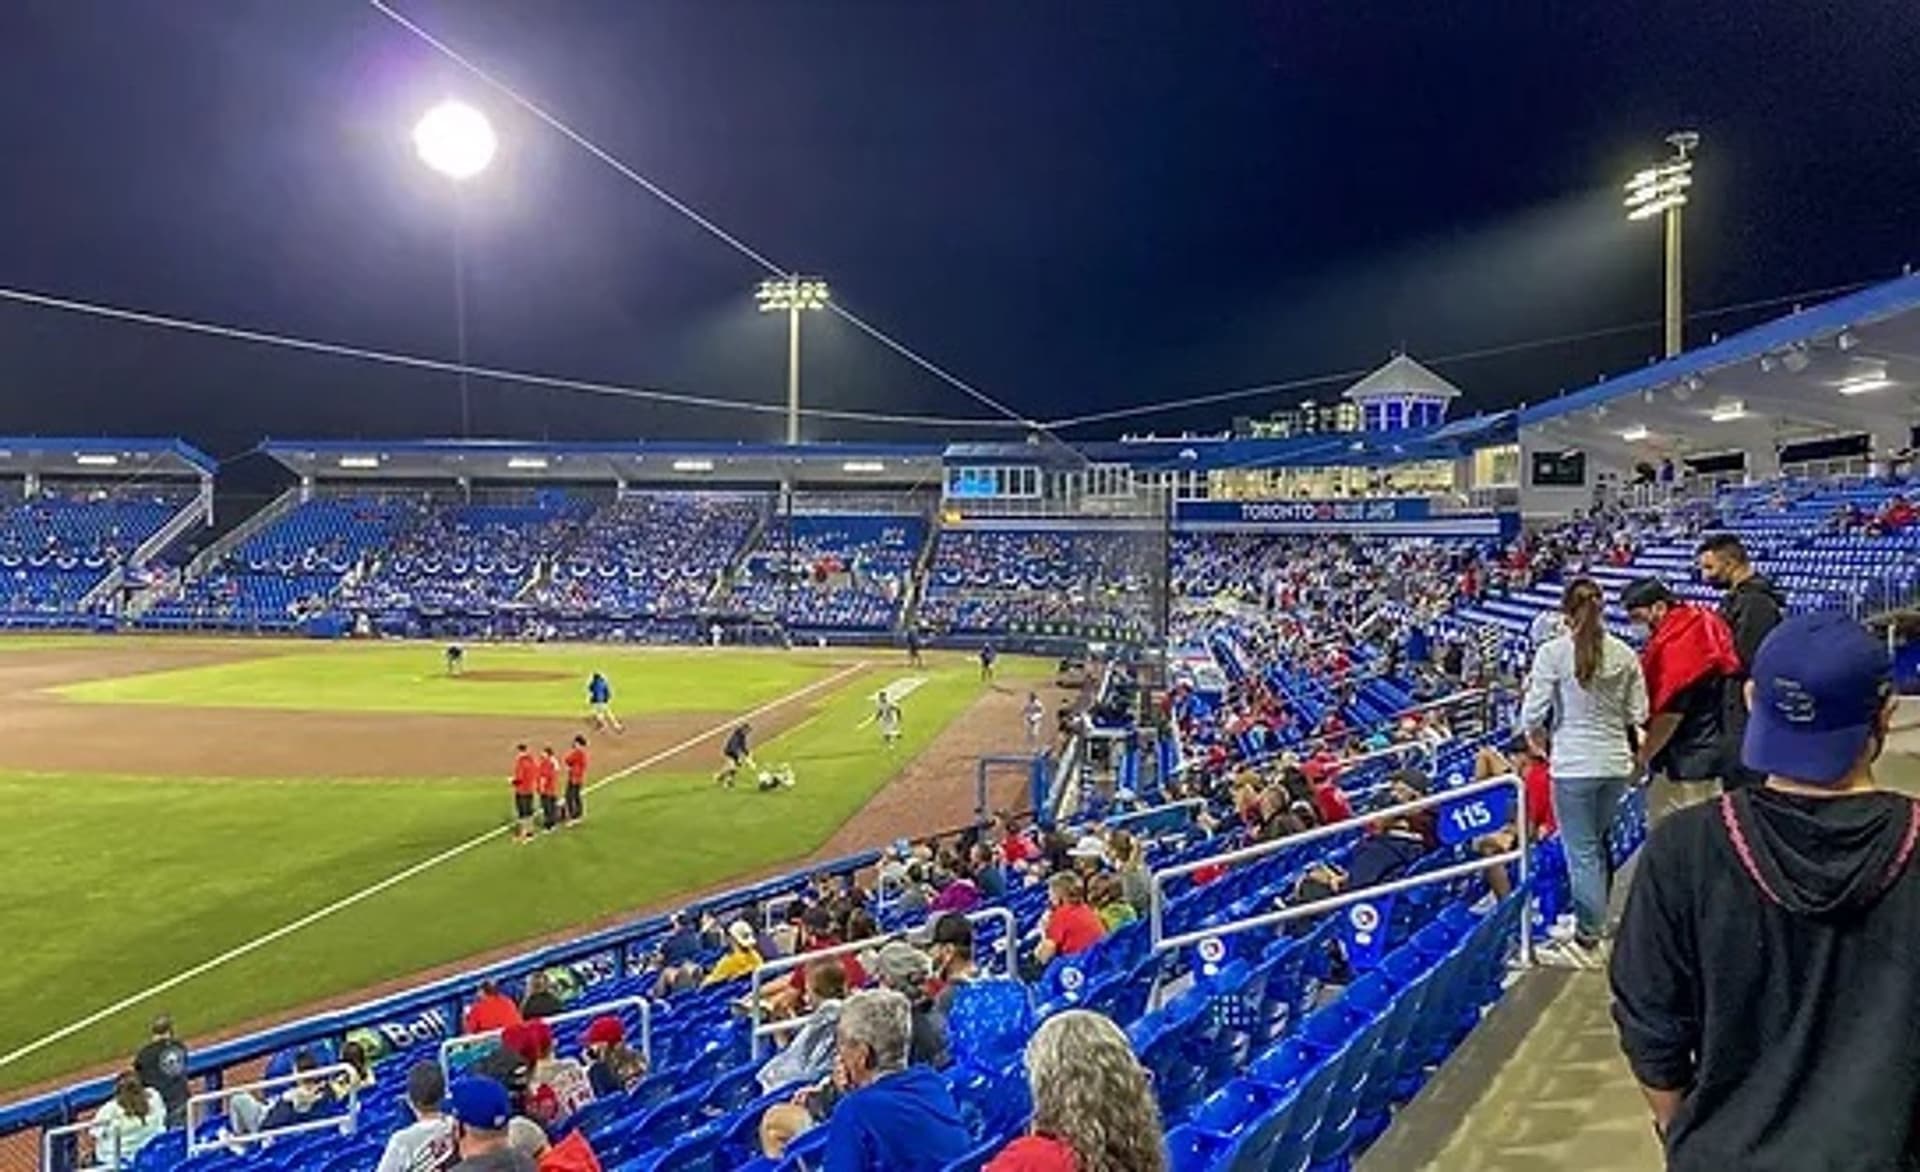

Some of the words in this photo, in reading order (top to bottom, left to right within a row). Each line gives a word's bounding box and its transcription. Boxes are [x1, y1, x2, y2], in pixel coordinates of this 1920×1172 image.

[1241, 503, 1315, 520] TORONTO
[1451, 801, 1491, 831] 115
[380, 1008, 445, 1046] Ball
